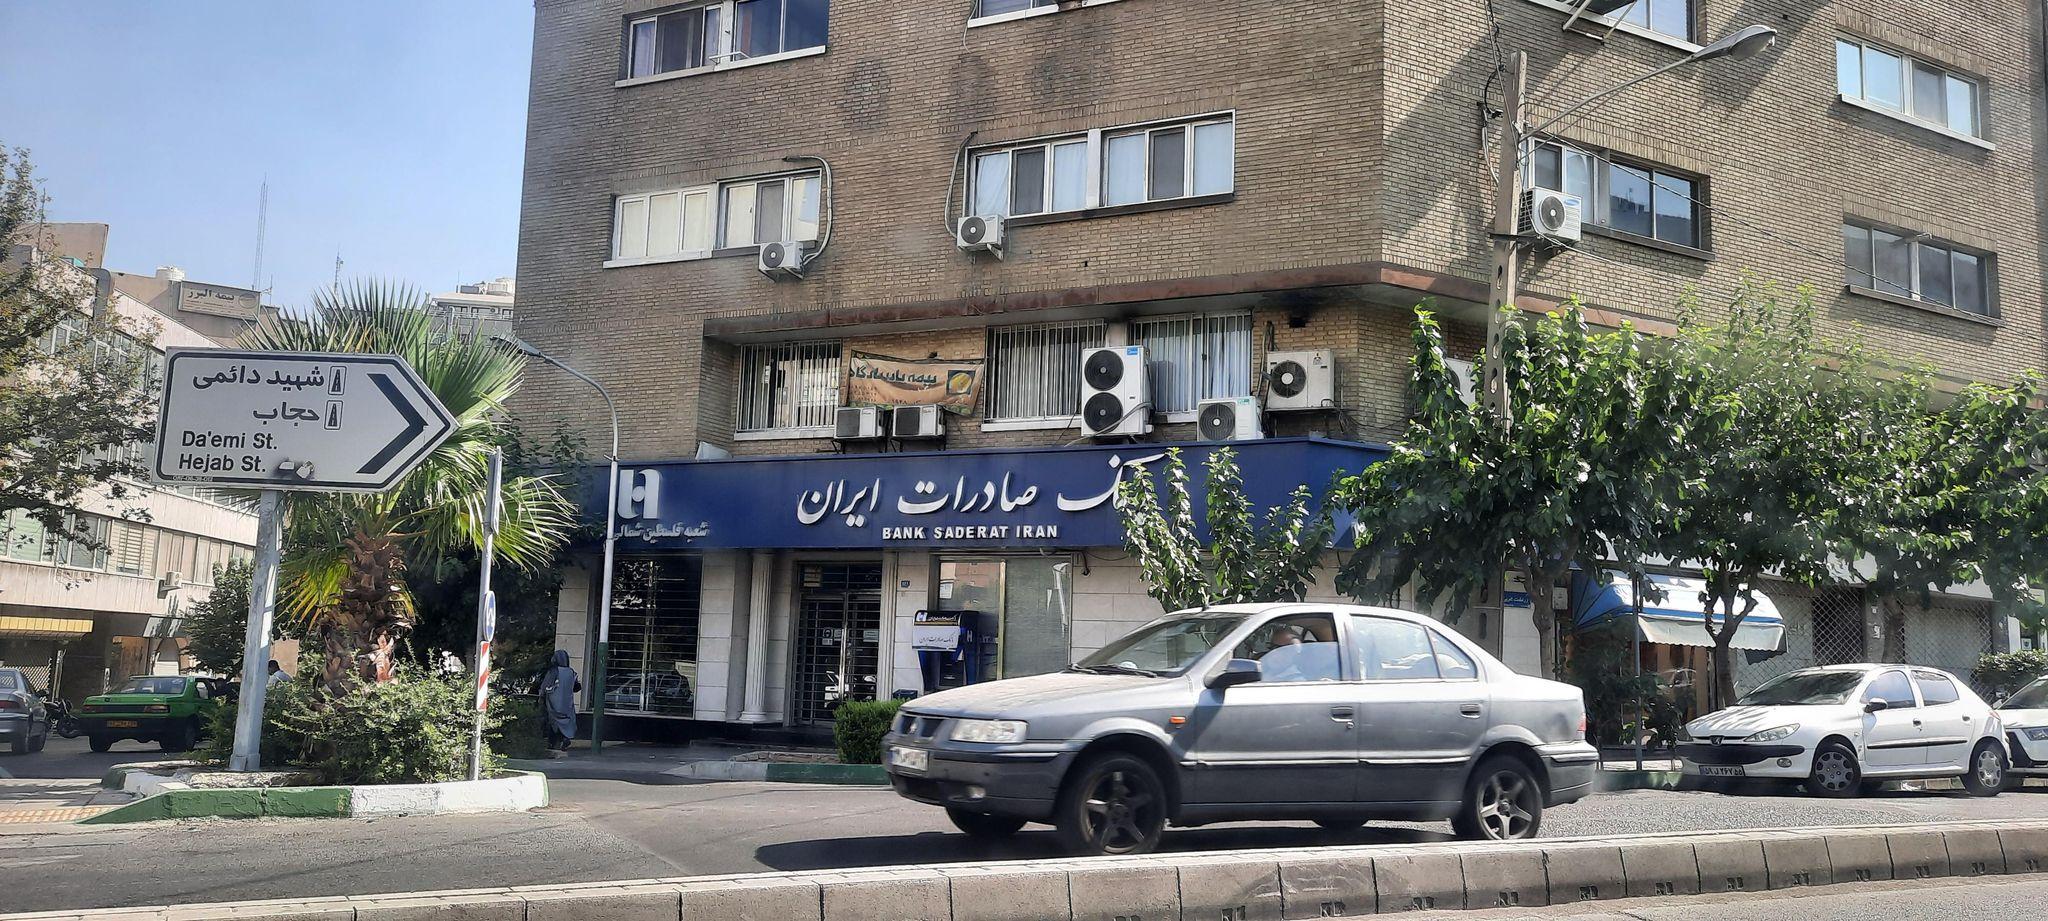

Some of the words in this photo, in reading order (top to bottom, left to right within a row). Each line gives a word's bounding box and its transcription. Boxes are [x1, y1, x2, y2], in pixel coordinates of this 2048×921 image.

[193, 365, 260, 390] دائمی
[266, 366, 325, 391] شهید
[252, 401, 321, 427] حجاب
[182, 430, 246, 449] Da'emi
[253, 433, 278, 450] St.
[178, 453, 235, 473] Hejab
[241, 455, 266, 473] St.
[797, 477, 881, 528] ایران
[897, 471, 1039, 515] صادرات
[642, 521, 685, 544] فلسطین
[684, 521, 709, 543] شعبه
[882, 526, 927, 541] BANK
[933, 524, 1008, 540] SADERAT
[1015, 524, 1059, 539] IRAN
